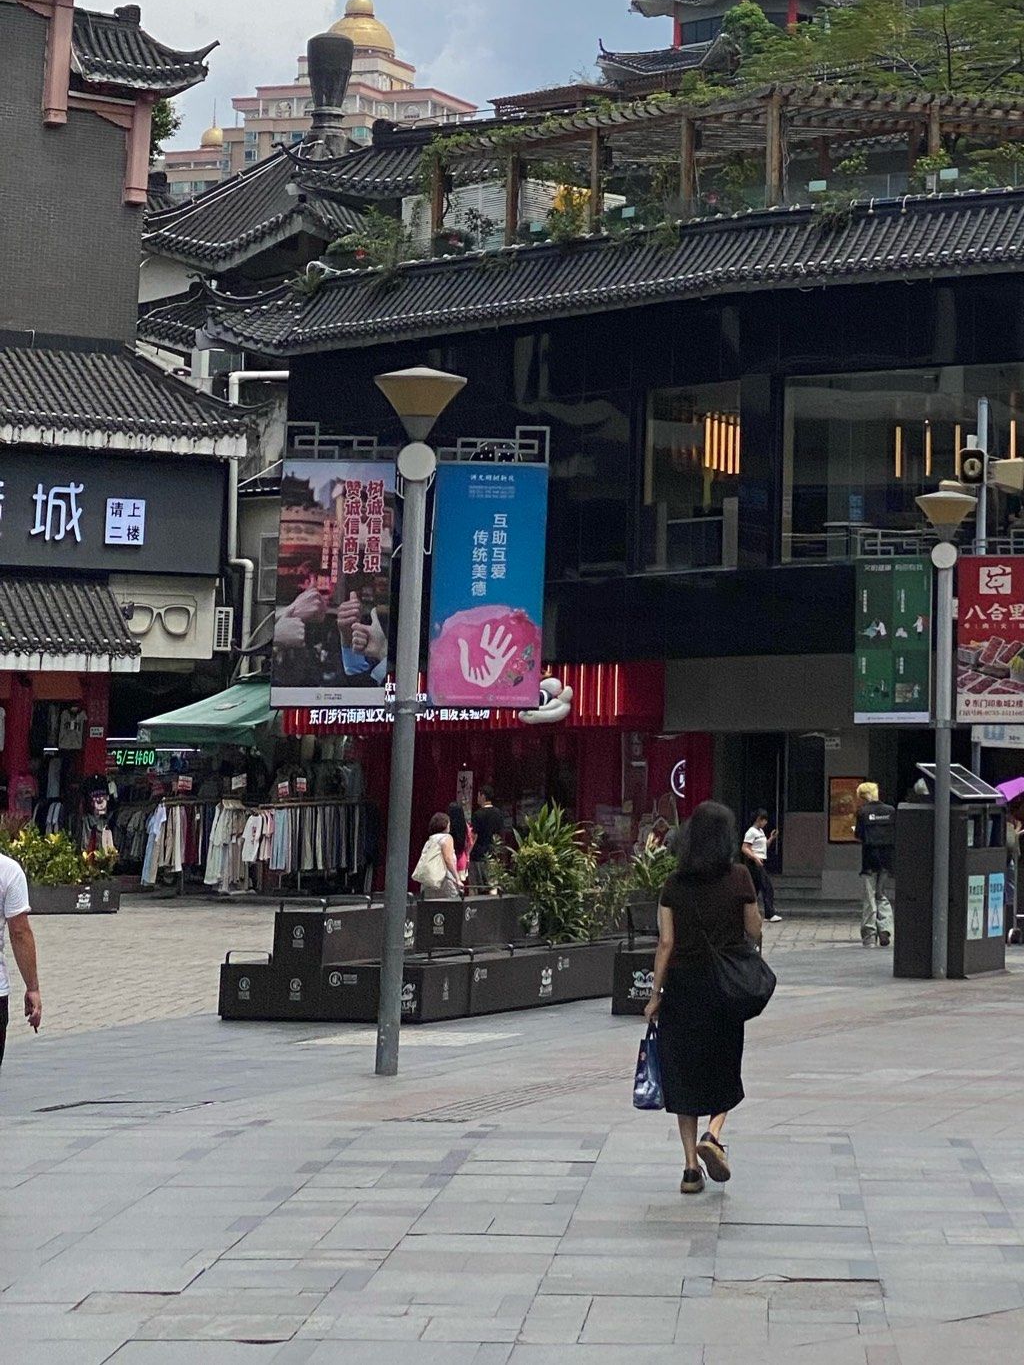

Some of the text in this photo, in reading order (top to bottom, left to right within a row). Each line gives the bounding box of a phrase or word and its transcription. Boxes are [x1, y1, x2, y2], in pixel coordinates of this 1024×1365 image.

[343, 480, 362, 574] 赞诚信商家
[364, 479, 384, 572] 树诚信意识
[471, 530, 489, 597] 传统美德
[491, 514, 508, 579] 互助互爱
